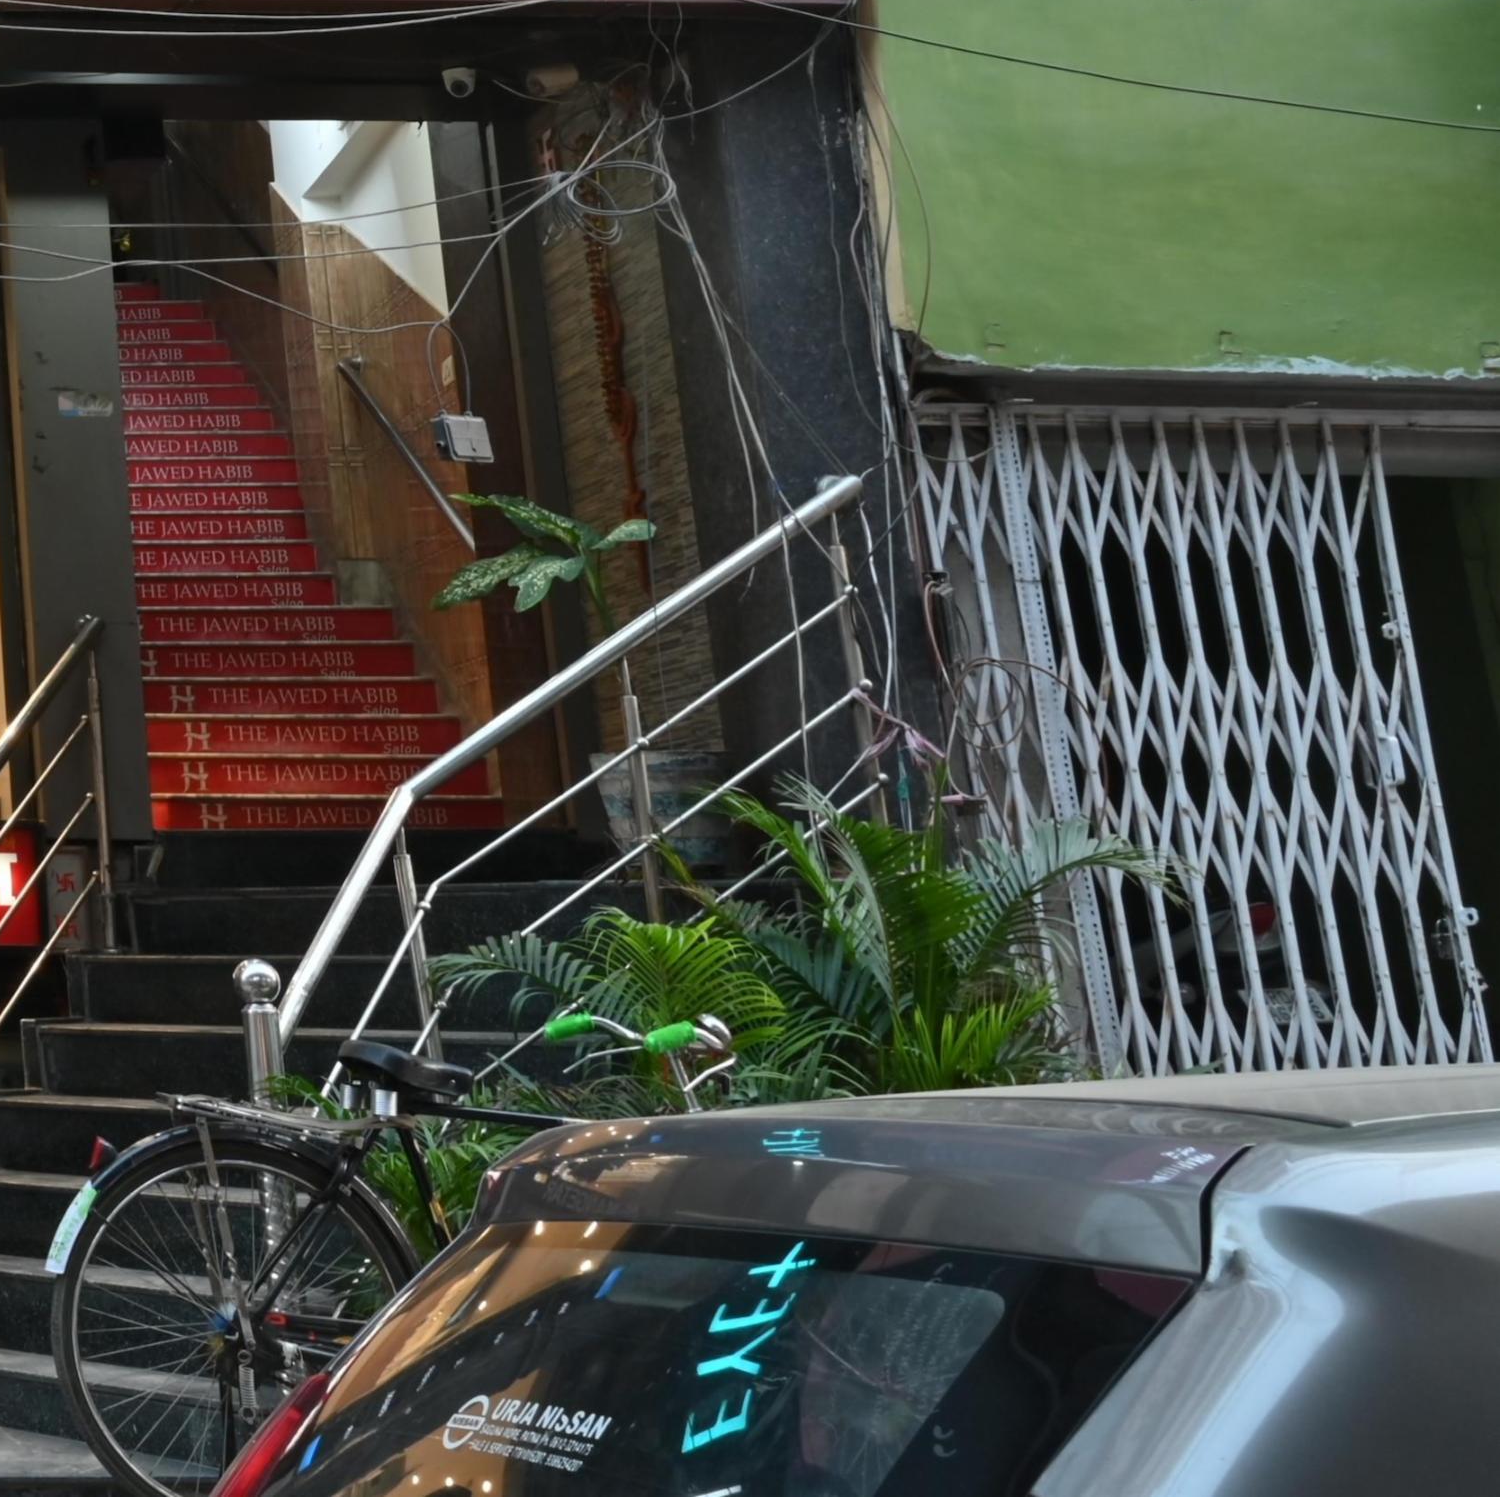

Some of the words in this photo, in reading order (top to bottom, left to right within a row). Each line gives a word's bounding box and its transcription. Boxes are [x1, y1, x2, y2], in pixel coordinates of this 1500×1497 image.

[158, 392, 209, 405] HABIB
[128, 414, 186, 431] JAWED
[189, 414, 242, 428] HABIB
[185, 439, 240, 454] HABIB
[134, 466, 194, 483] JAWED
[198, 465, 254, 479] HABIB
[147, 492, 209, 510] JAWED
[212, 491, 270, 505] HABIB
[161, 520, 224, 537] JAWED
[227, 519, 286, 534] HABIB
[162, 550, 226, 568] JAWED
[230, 549, 290, 564] HABIB
[174, 583, 239, 601] JAWED
[243, 582, 304, 597] HABIB
[156, 617, 197, 633] THE
[202, 617, 270, 635] JAWED
[274, 616, 337, 632] HABIB
[171, 652, 213, 669] THE
[218, 652, 286, 671] JAWED
[291, 651, 355, 668] HABIB
[208, 687, 251, 704] THE
[257, 687, 328, 707] JAWED
[332, 687, 398, 704] HABIB
[223, 725, 268, 742] THE
[274, 725, 348, 744] JAWED
[353, 724, 420, 742] HABIB
[383, 743, 422, 755] Salon
[222, 764, 265, 782] THE
[273, 764, 349, 785] JAWED
[241, 806, 288, 825] THE
[294, 806, 372, 827] JAWED
[491, 1397, 540, 1426] URJA
